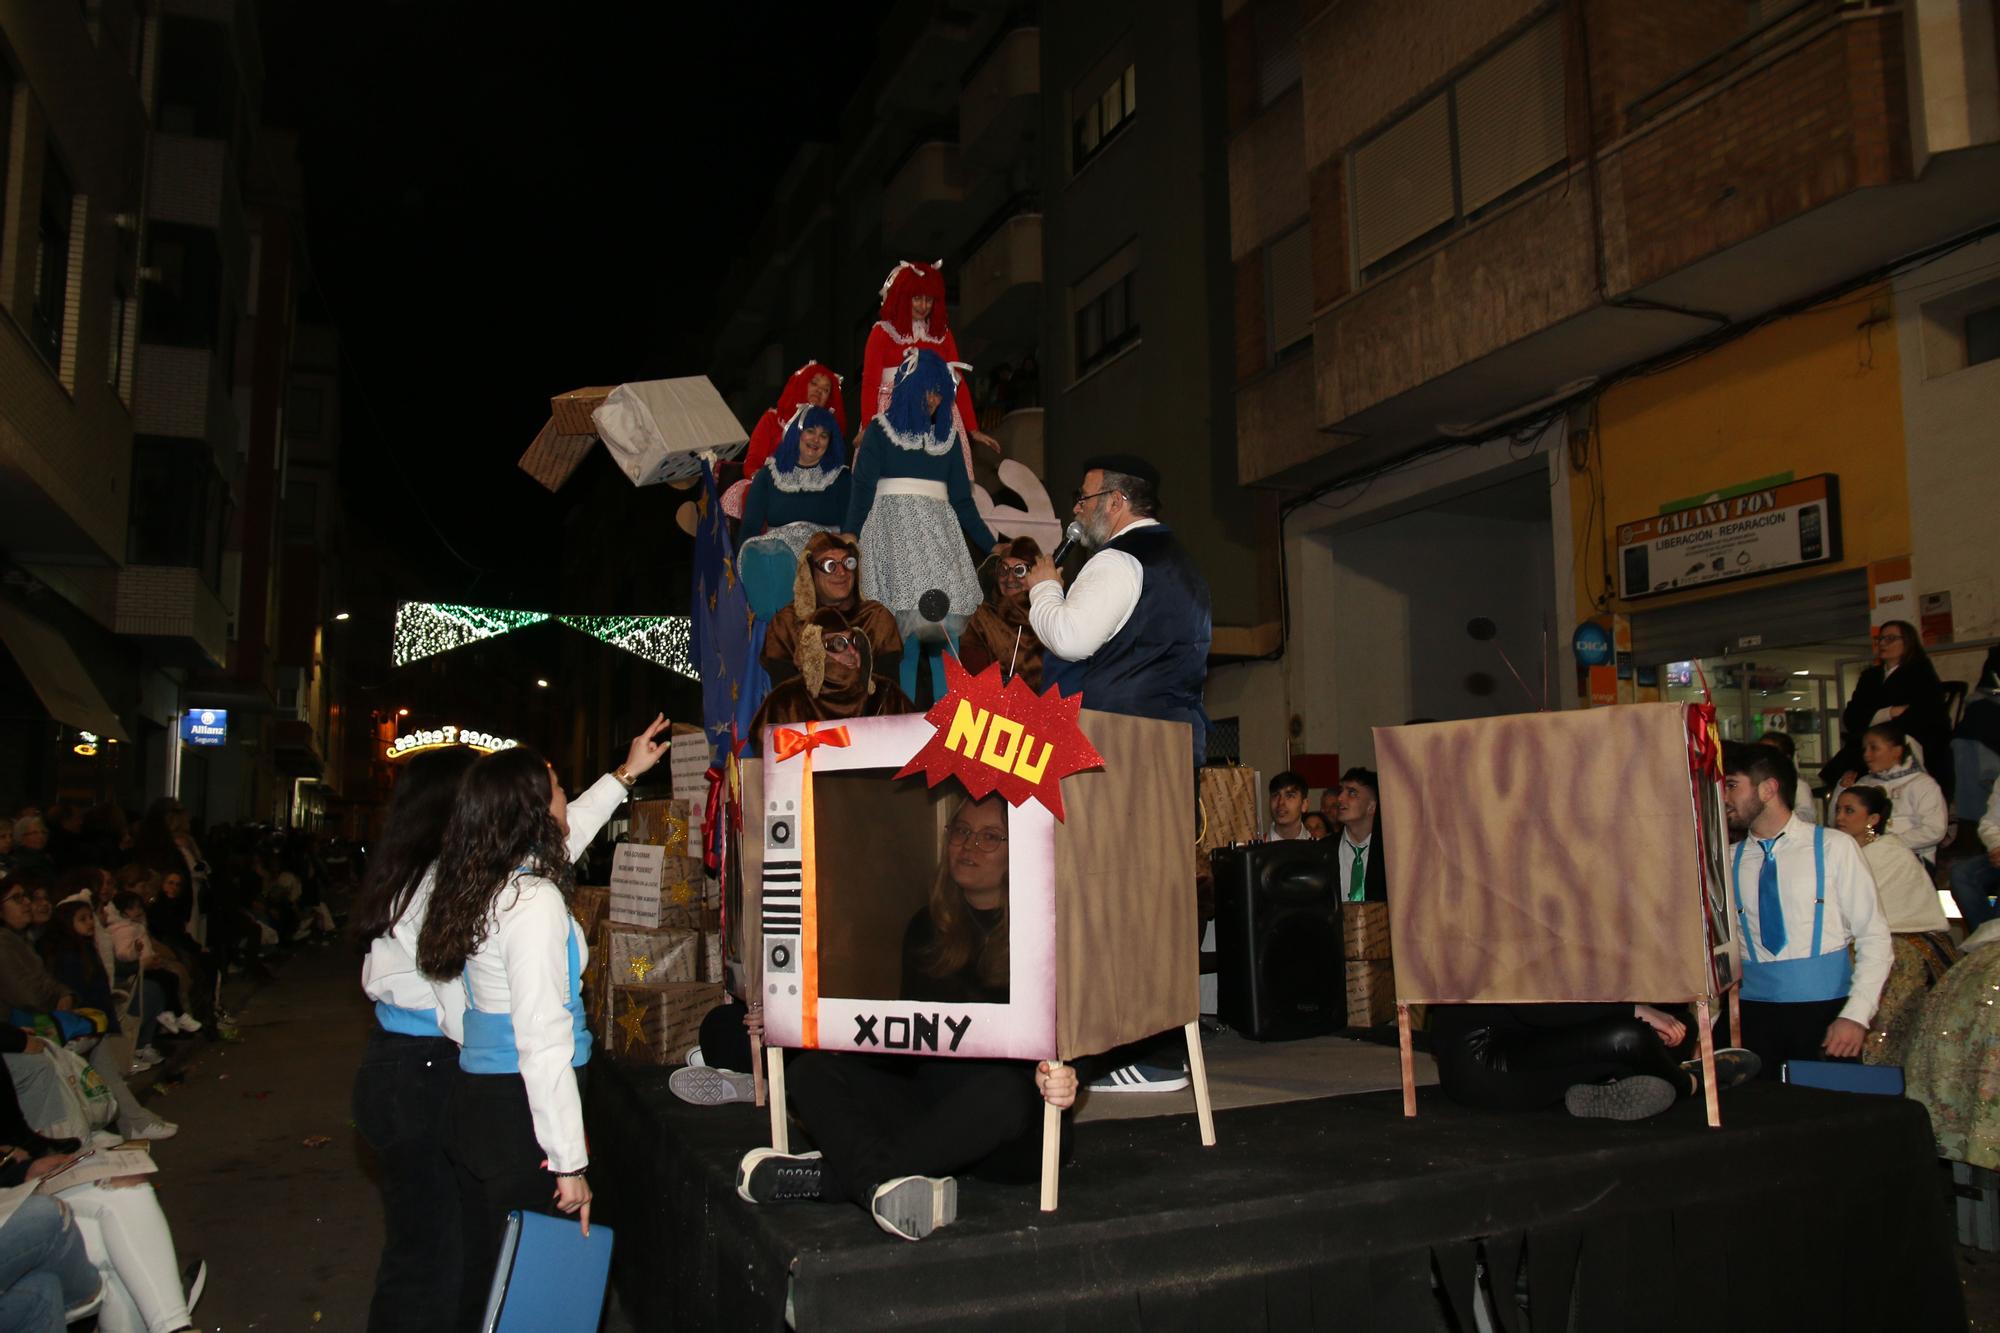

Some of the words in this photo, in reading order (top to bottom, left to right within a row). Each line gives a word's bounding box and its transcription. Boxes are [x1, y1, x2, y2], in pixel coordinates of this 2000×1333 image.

[1657, 502, 1730, 534] GALAXY
[1736, 491, 1778, 516] FON
[191, 725, 225, 735] Allianz
[944, 699, 1055, 785] NOU
[854, 1013, 972, 1053] XONY
